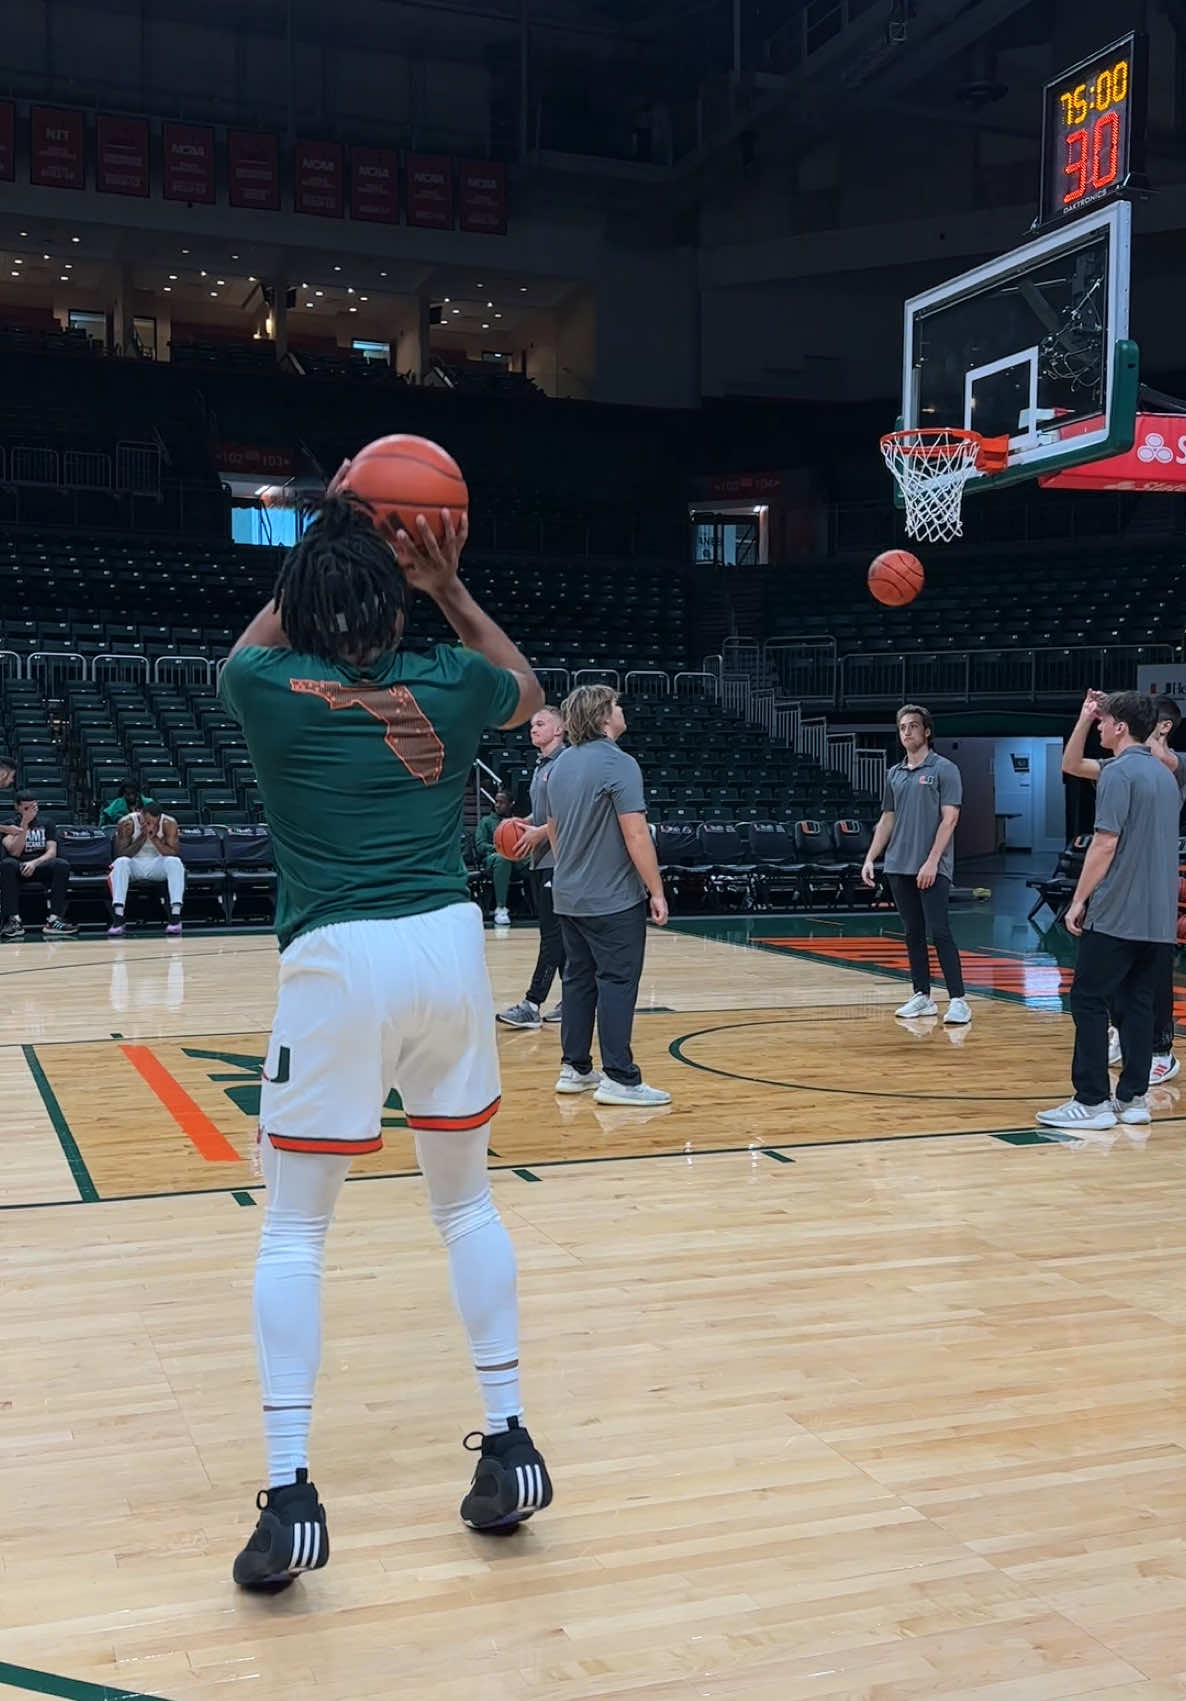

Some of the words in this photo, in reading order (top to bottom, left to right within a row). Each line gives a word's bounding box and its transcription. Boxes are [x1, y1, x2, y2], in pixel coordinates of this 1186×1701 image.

[1063, 111, 1120, 204] 30
[1063, 188, 1107, 214] DAKTRONICS
[25, 828, 46, 842] AMI
